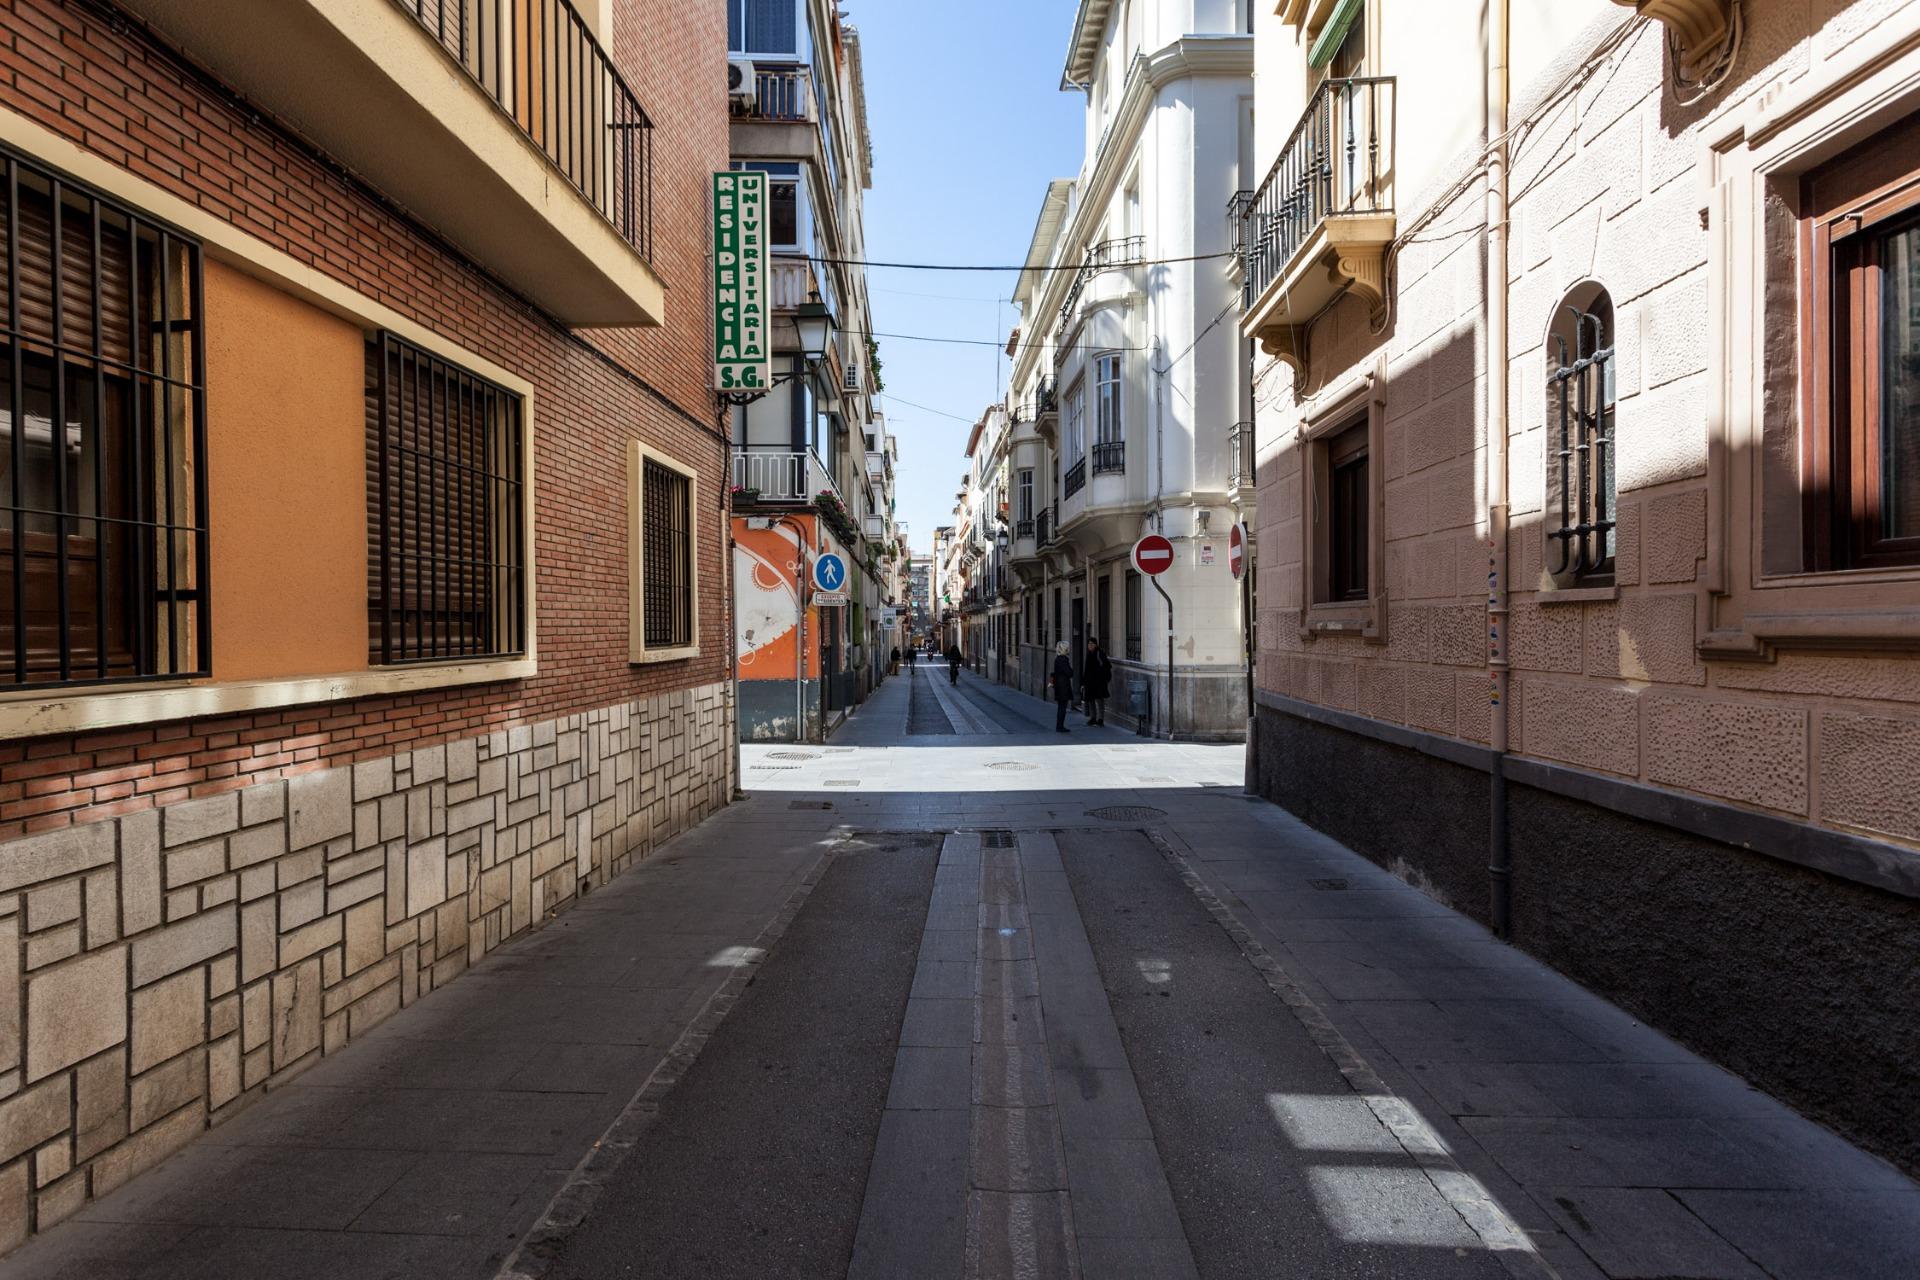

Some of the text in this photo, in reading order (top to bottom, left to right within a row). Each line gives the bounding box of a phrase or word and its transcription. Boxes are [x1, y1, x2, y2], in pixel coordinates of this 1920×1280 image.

[718, 177, 737, 359] RESIDENCIA
[742, 180, 760, 355] UNIVERSITARIA
[721, 366, 764, 388] S.G.
